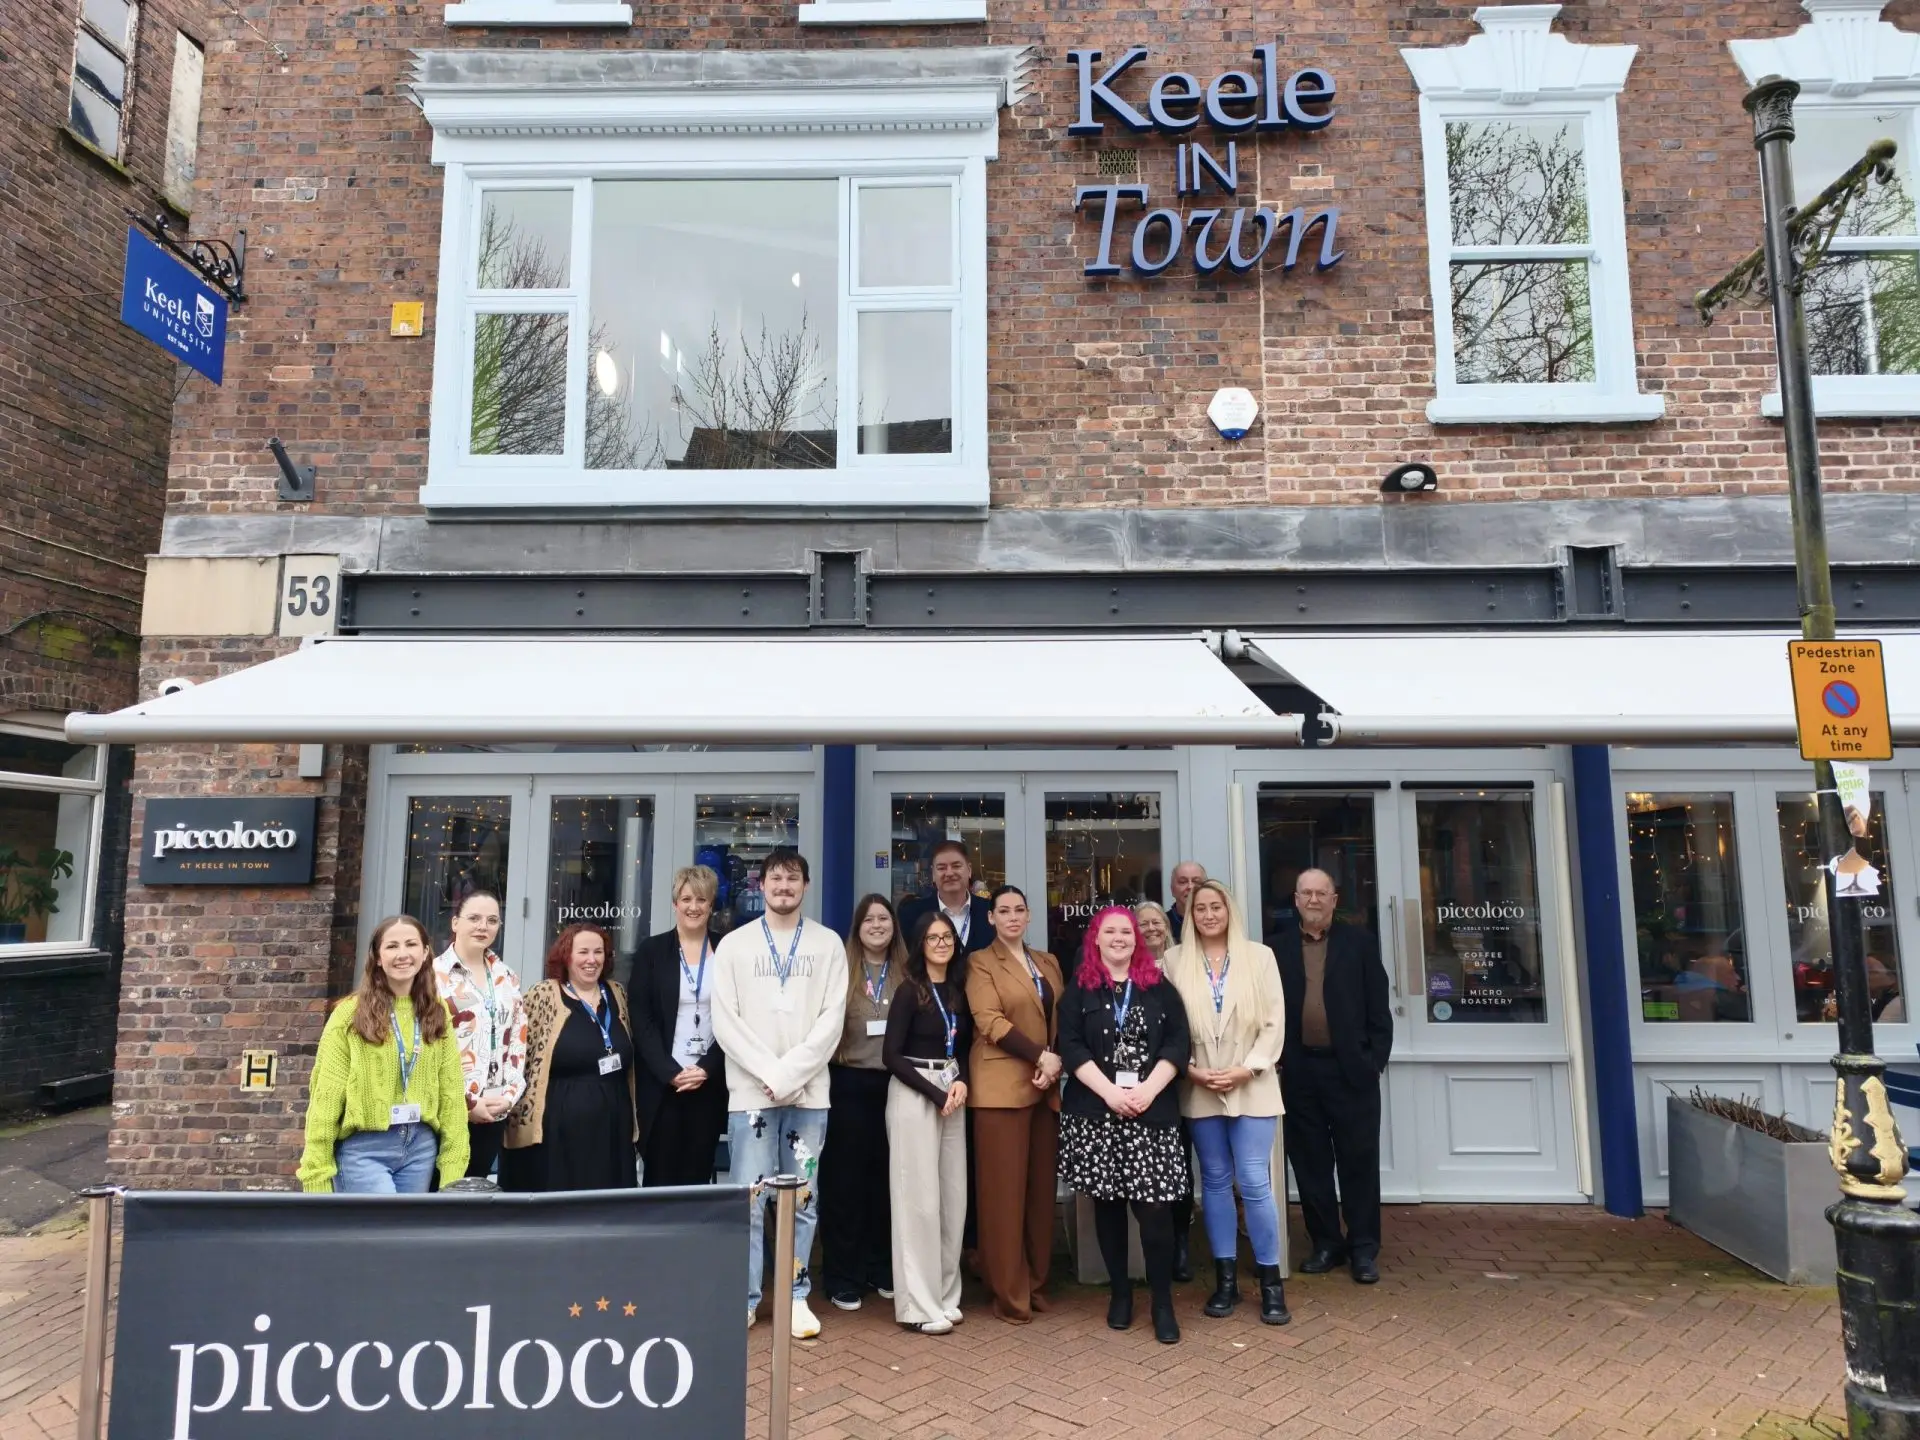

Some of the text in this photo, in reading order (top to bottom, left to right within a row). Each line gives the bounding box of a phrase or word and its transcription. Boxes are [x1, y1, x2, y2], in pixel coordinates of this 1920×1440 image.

[1066, 42, 1337, 136] Keele
[1175, 141, 1238, 198] IN
[1074, 183, 1346, 278] Town
[145, 277, 191, 325] Keele
[143, 302, 212, 354] UNIVERSITY
[287, 575, 331, 616] 53
[1796, 646, 1876, 658] Pedestrian
[1820, 661, 1856, 673] Zone
[1821, 724, 1868, 738] At any
[1830, 740, 1863, 752] time
[152, 821, 298, 858] piccoloco
[180, 862, 192, 870] AT
[195, 862, 225, 870] KEELE
[557, 901, 642, 923] piccoloco
[1437, 901, 1524, 923] piccoloco
[1464, 951, 1503, 959] COFFEE
[246, 1054, 273, 1087] H
[168, 1303, 695, 1440] piccoloco
